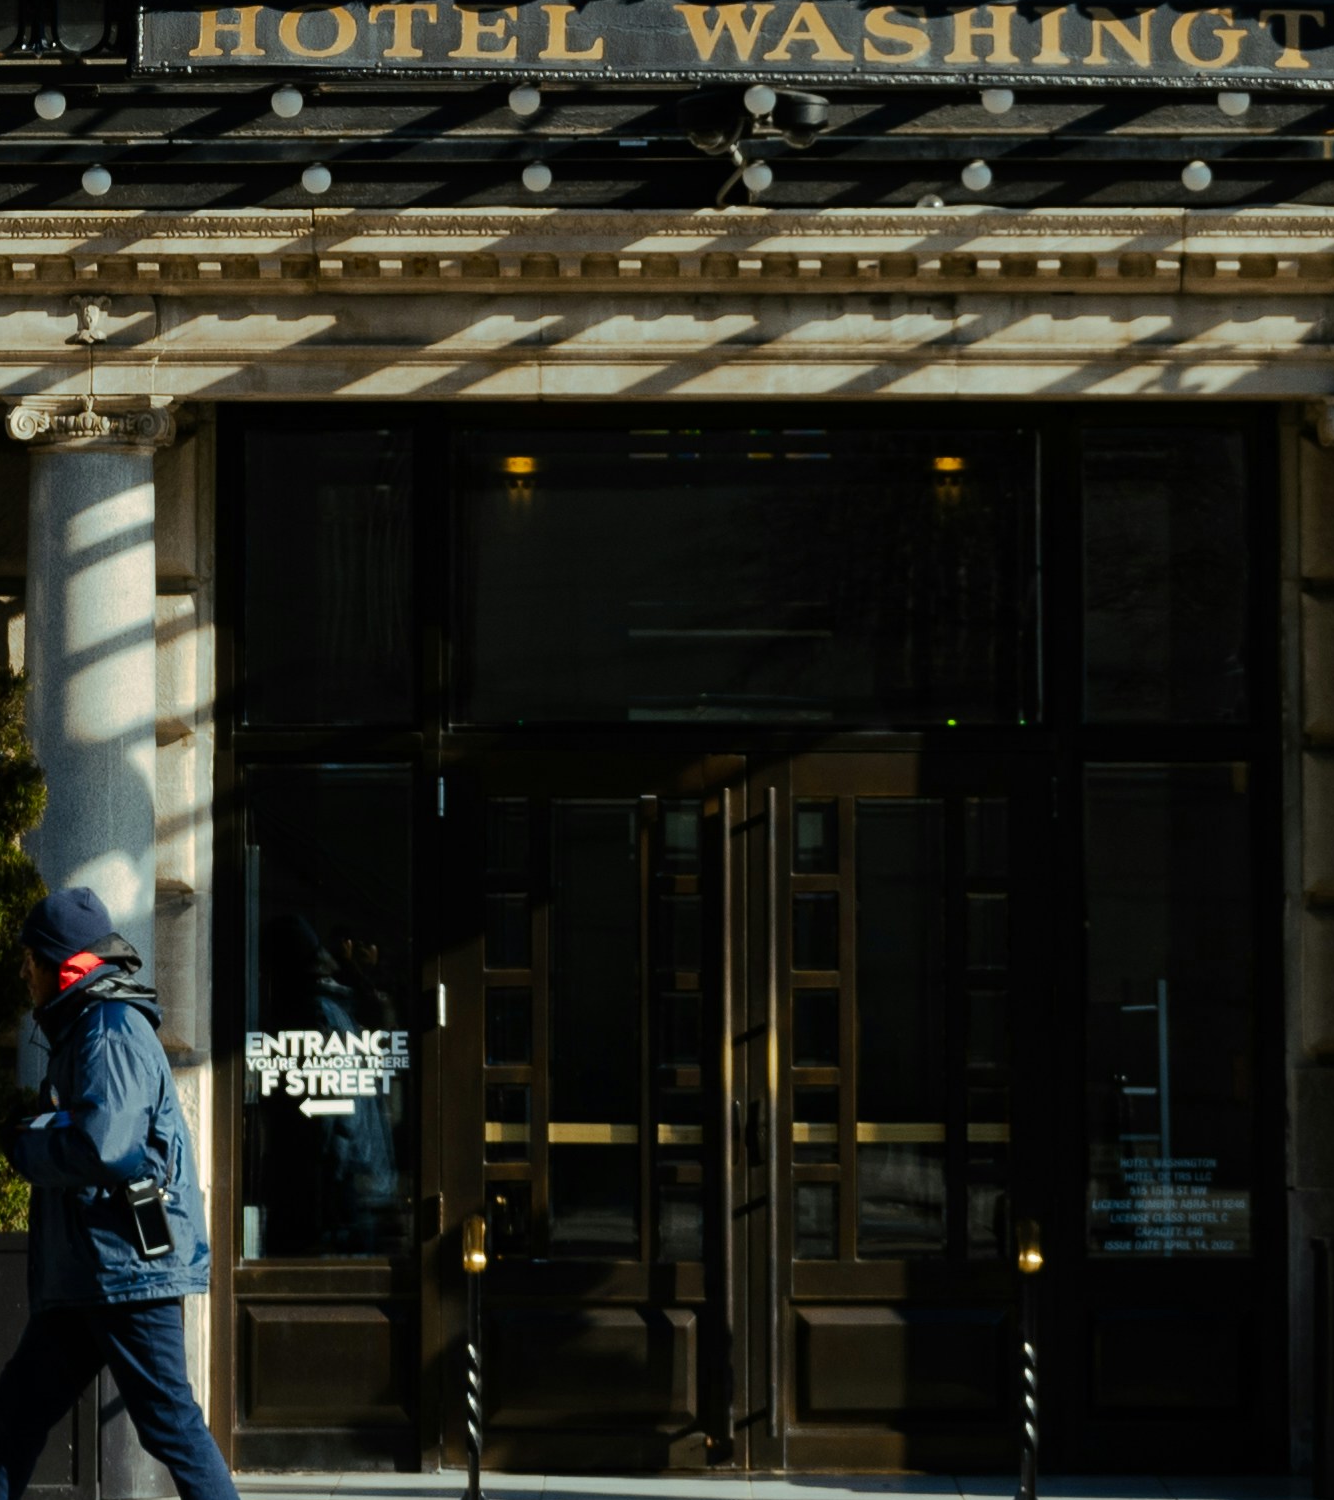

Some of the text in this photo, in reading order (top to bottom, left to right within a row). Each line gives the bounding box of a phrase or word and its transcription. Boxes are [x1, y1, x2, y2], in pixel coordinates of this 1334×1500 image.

[188, 3, 604, 60] HOTEL
[245, 1030, 409, 1056] ENTRANCE
[246, 1055, 410, 1071] YOU'RE ALMOST THERE
[261, 1069, 396, 1096] F STREET
[1120, 1158, 1217, 1168] HOTEL WASHINGTON
[1124, 1172, 1154, 1182] HOTEL
[1191, 1186, 1207, 1195] NW
[1092, 1199, 1131, 1209] LICENSE
[1110, 1212, 1149, 1222] LICENSE
[1188, 1212, 1218, 1222] HOTEL
[1104, 1240, 1132, 1250] ISSUE
[1163, 1240, 1191, 1250] APRIL
